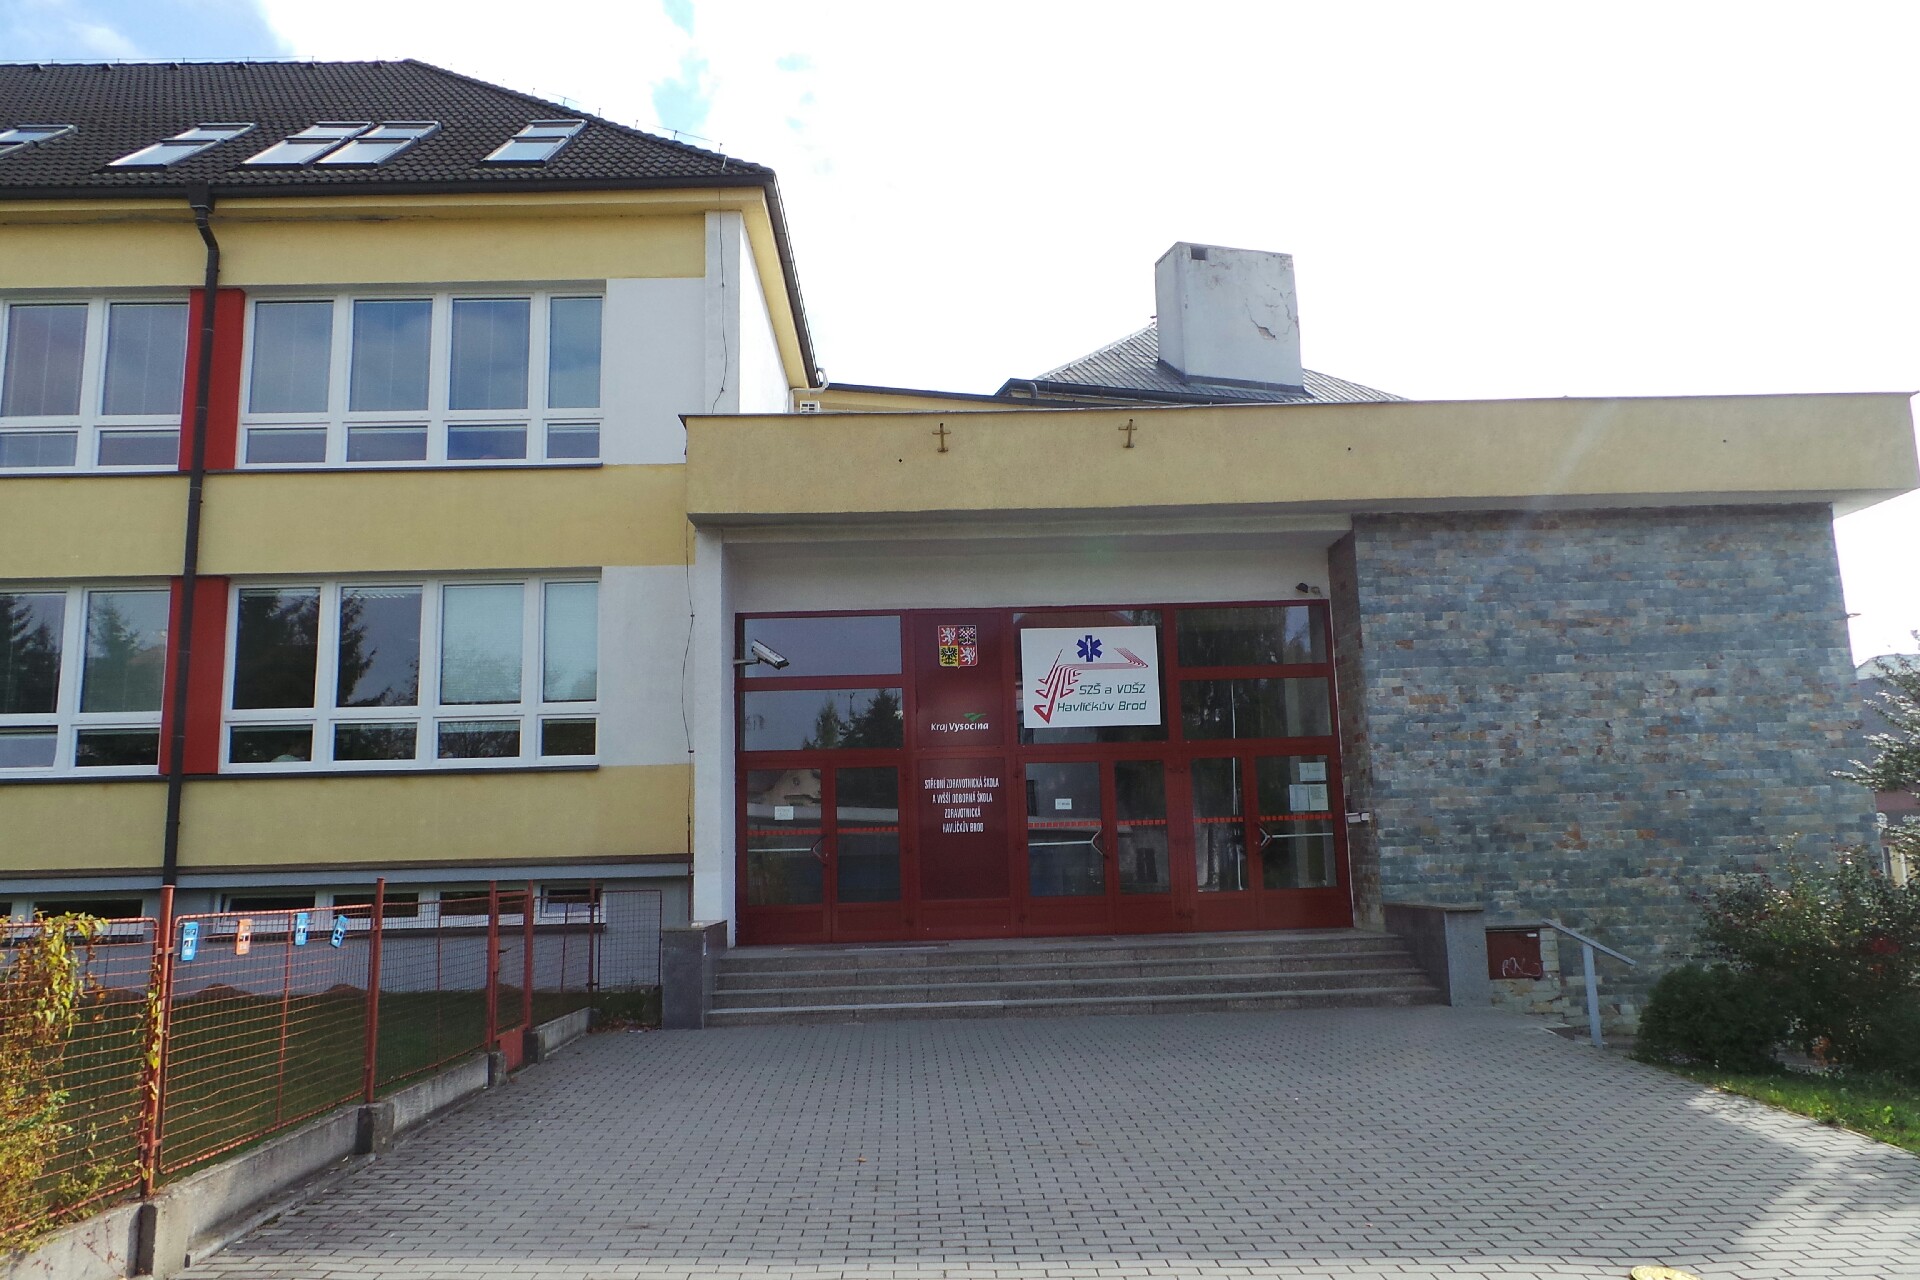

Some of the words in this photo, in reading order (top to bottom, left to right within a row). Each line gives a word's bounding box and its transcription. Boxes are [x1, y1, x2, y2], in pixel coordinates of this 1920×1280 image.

[1079, 682, 1101, 695] SZŠ
[1104, 686, 1112, 694] a
[1117, 681, 1146, 694] VOŠZ
[1057, 701, 1114, 712] Havlíčkův
[1118, 700, 1147, 711] Brod
[931, 722, 948, 733] Kraj
[983, 775, 1000, 788] ŠKOLA
[932, 794, 937, 804] A
[977, 790, 993, 803] ŠKOLA
[969, 822, 984, 833] BROD
